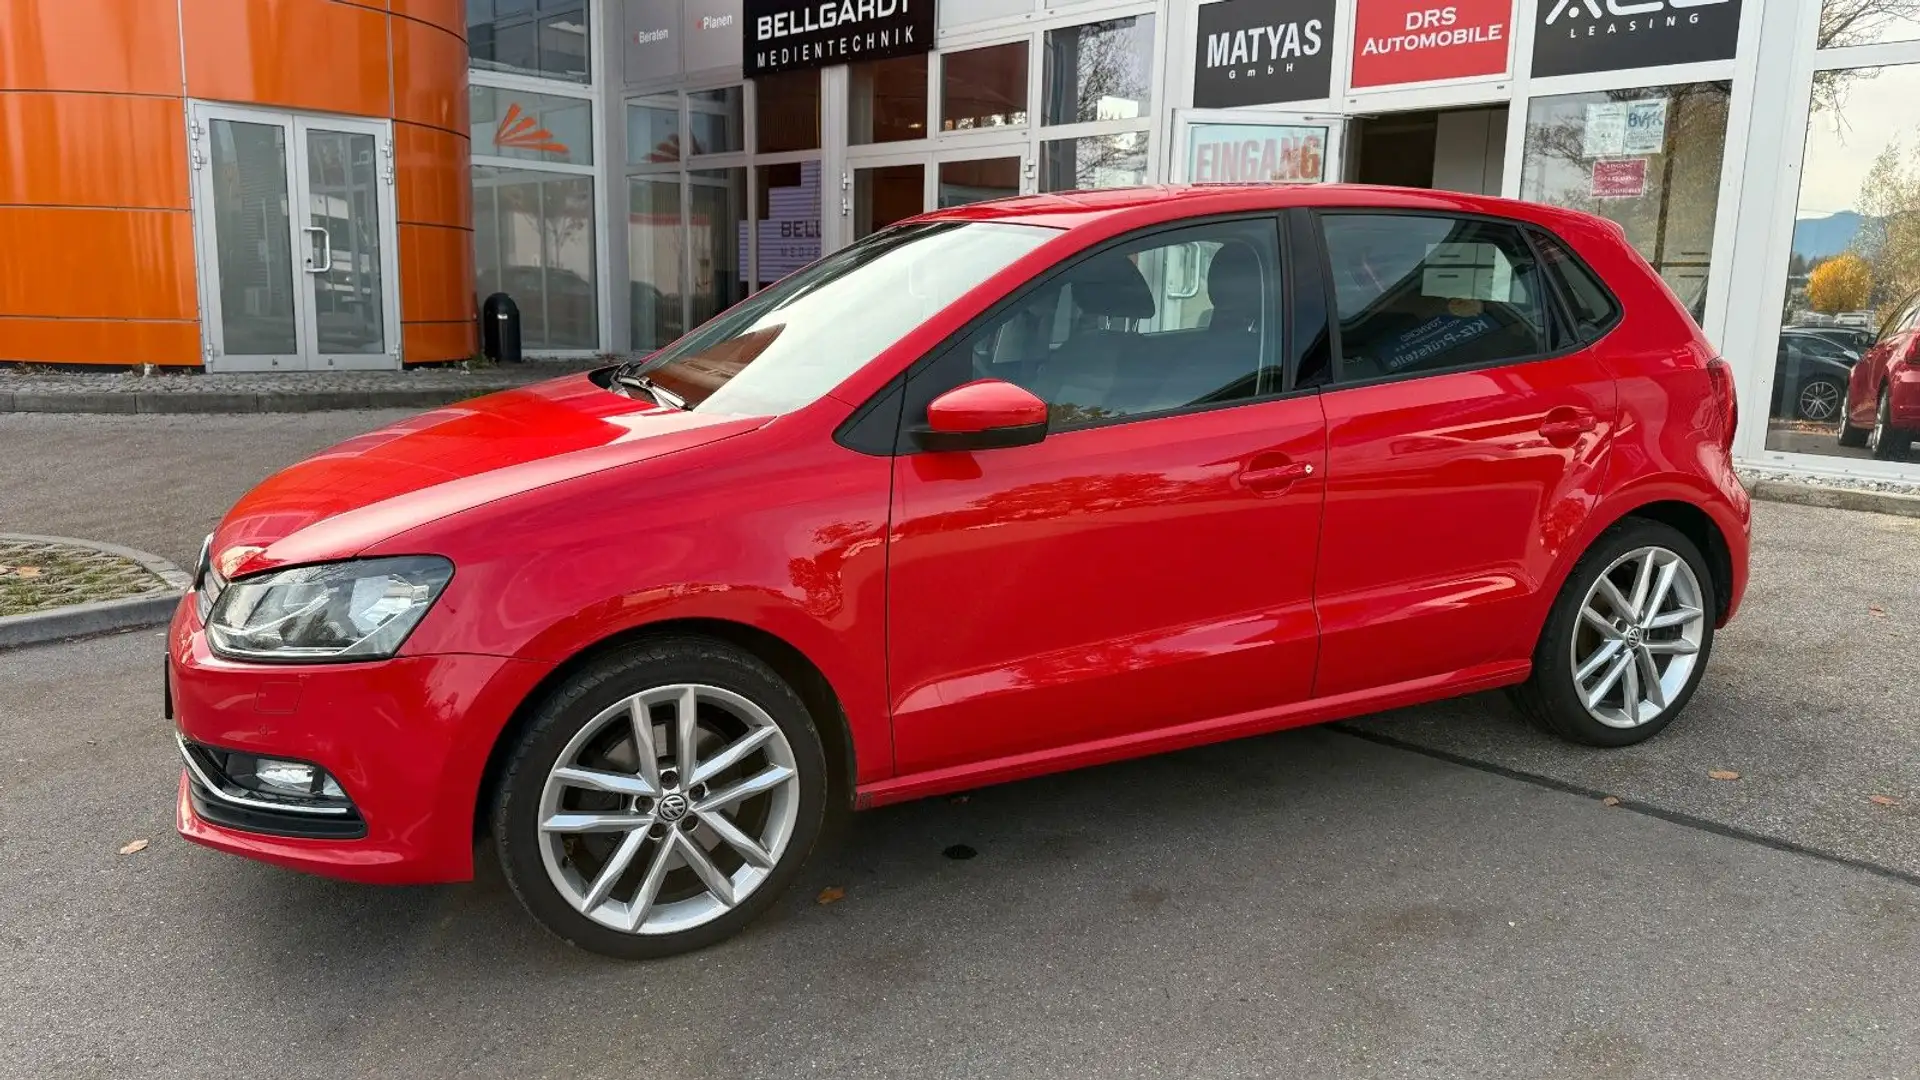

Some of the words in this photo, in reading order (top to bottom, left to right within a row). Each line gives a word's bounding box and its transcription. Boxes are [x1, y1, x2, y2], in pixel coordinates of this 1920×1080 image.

[703, 14, 733, 30] Planen
[757, 0, 909, 41] BELLGARDT
[1405, 7, 1457, 31] DRS
[1570, 13, 1699, 38] LEASING
[638, 28, 669, 44] Beraten
[757, 25, 914, 68] MEDIENTECHNIK
[1206, 19, 1323, 68] MATYAS
[1361, 24, 1503, 57] AUTOMOBILE
[1196, 135, 1320, 182] EINGANG
